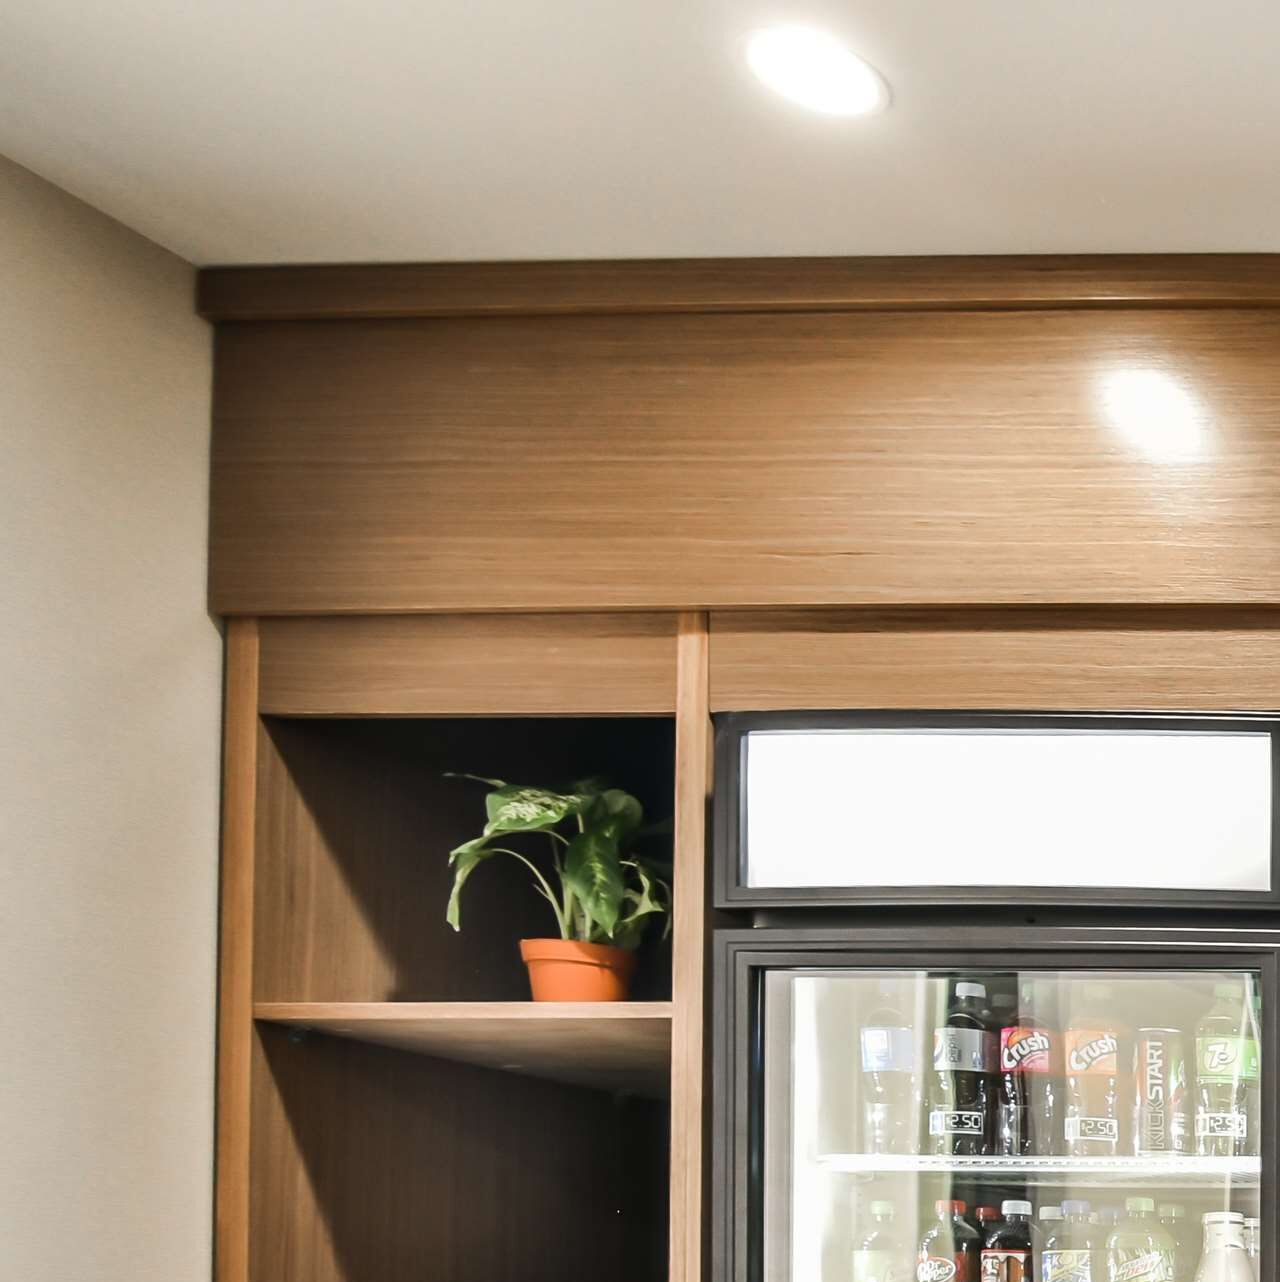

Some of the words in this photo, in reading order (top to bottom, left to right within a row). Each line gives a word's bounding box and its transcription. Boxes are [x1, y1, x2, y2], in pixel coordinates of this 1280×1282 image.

[1002, 1031, 1050, 1069] Crush
[1070, 1033, 1118, 1071] Crush
[1146, 1040, 1165, 1150] KICKSTART
